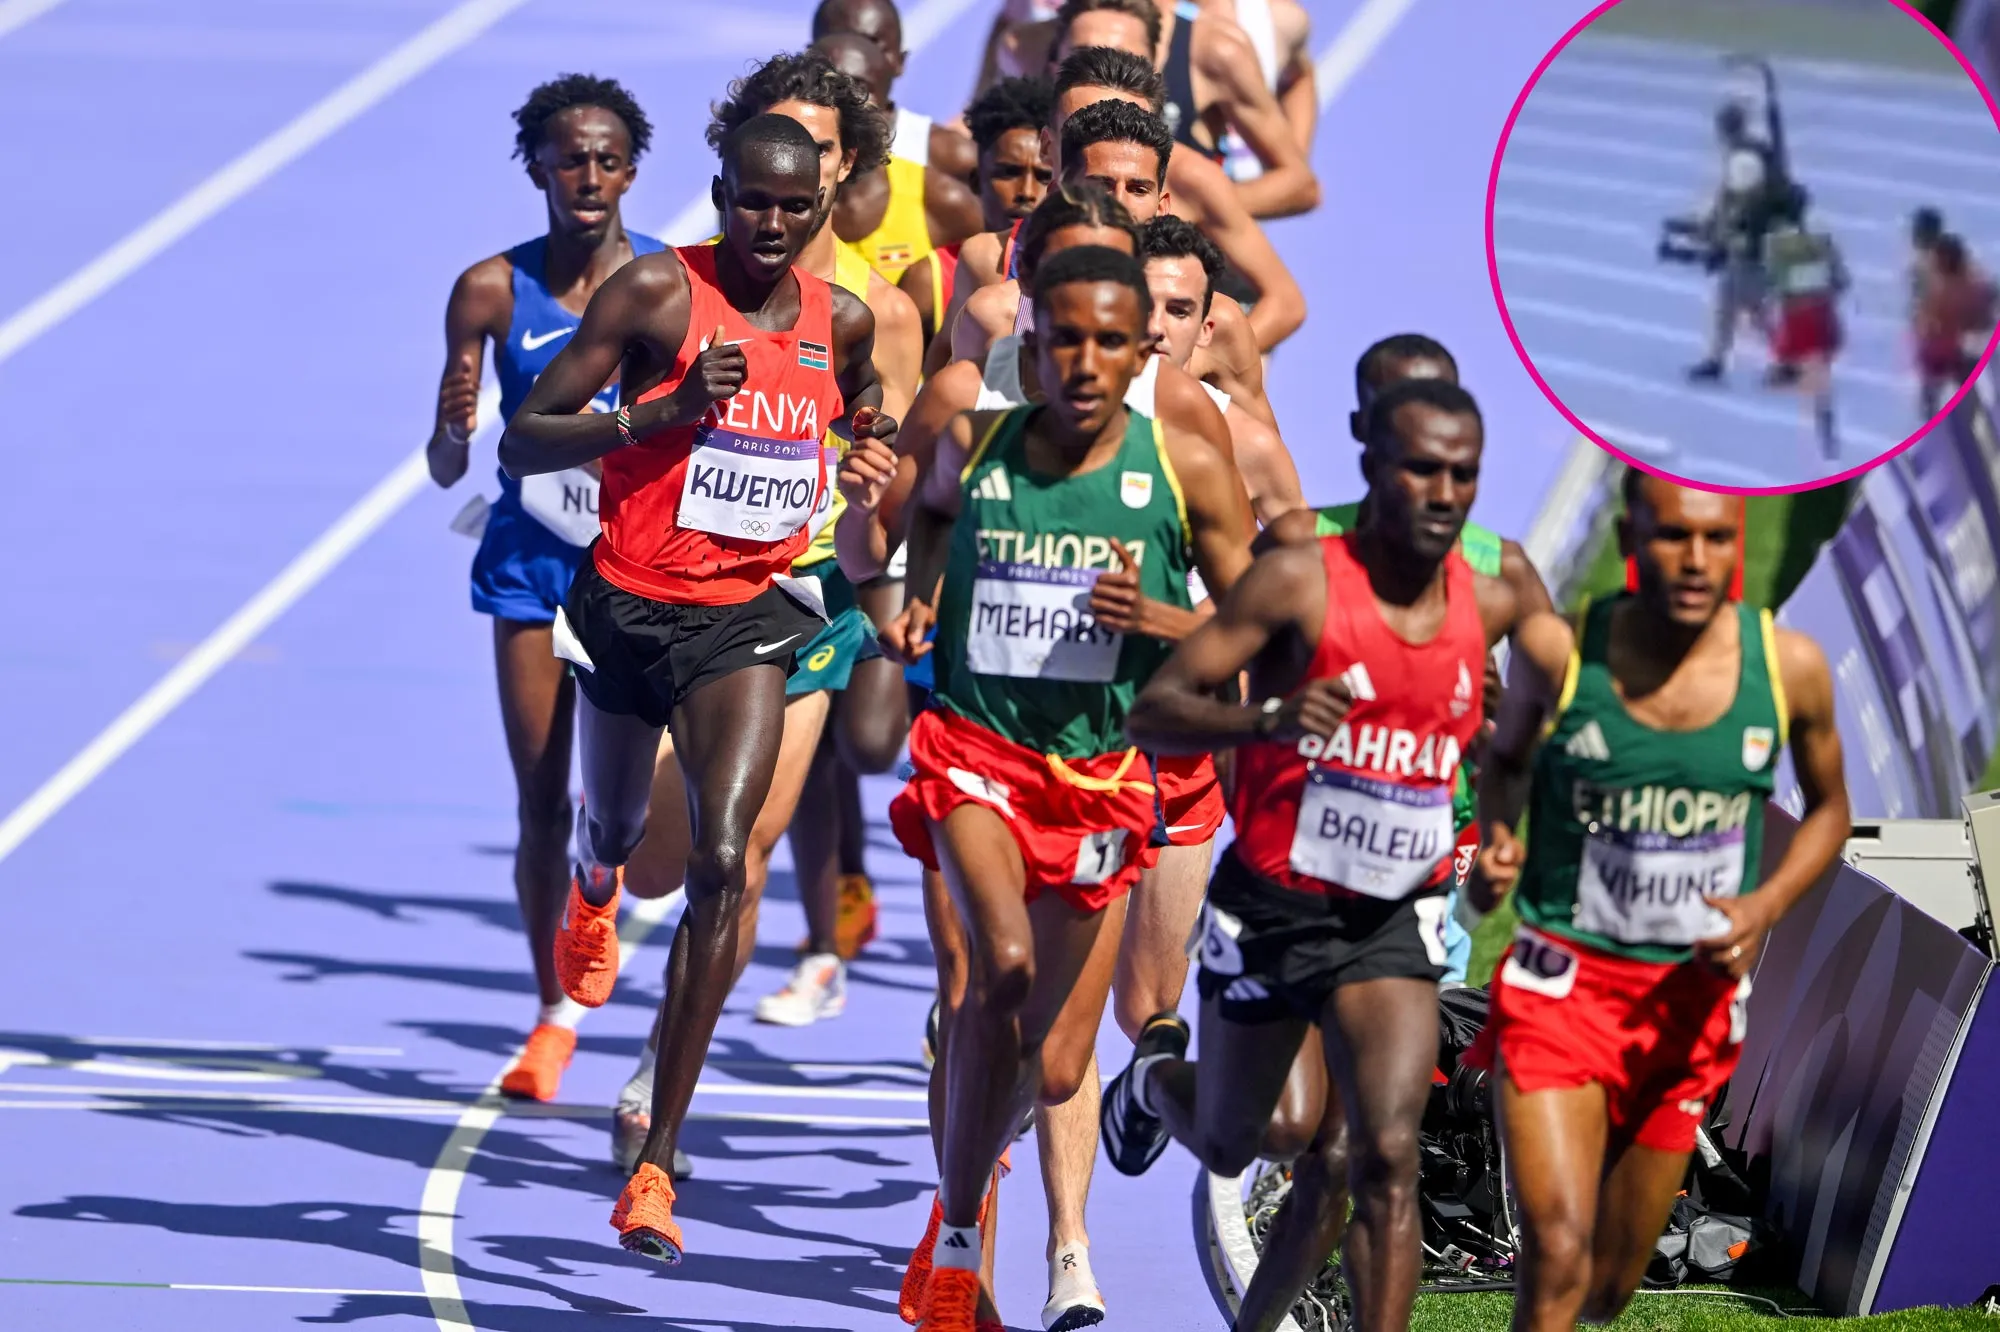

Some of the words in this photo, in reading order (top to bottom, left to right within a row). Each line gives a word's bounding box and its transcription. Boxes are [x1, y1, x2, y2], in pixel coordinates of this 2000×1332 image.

[734, 438, 770, 453] PARIS
[774, 445, 801, 456] 2024
[690, 463, 816, 510] KWEMOI
[1319, 806, 1438, 861] BALEW
[1514, 937, 1572, 979] 10
[1448, 1249, 1463, 1265] AP
